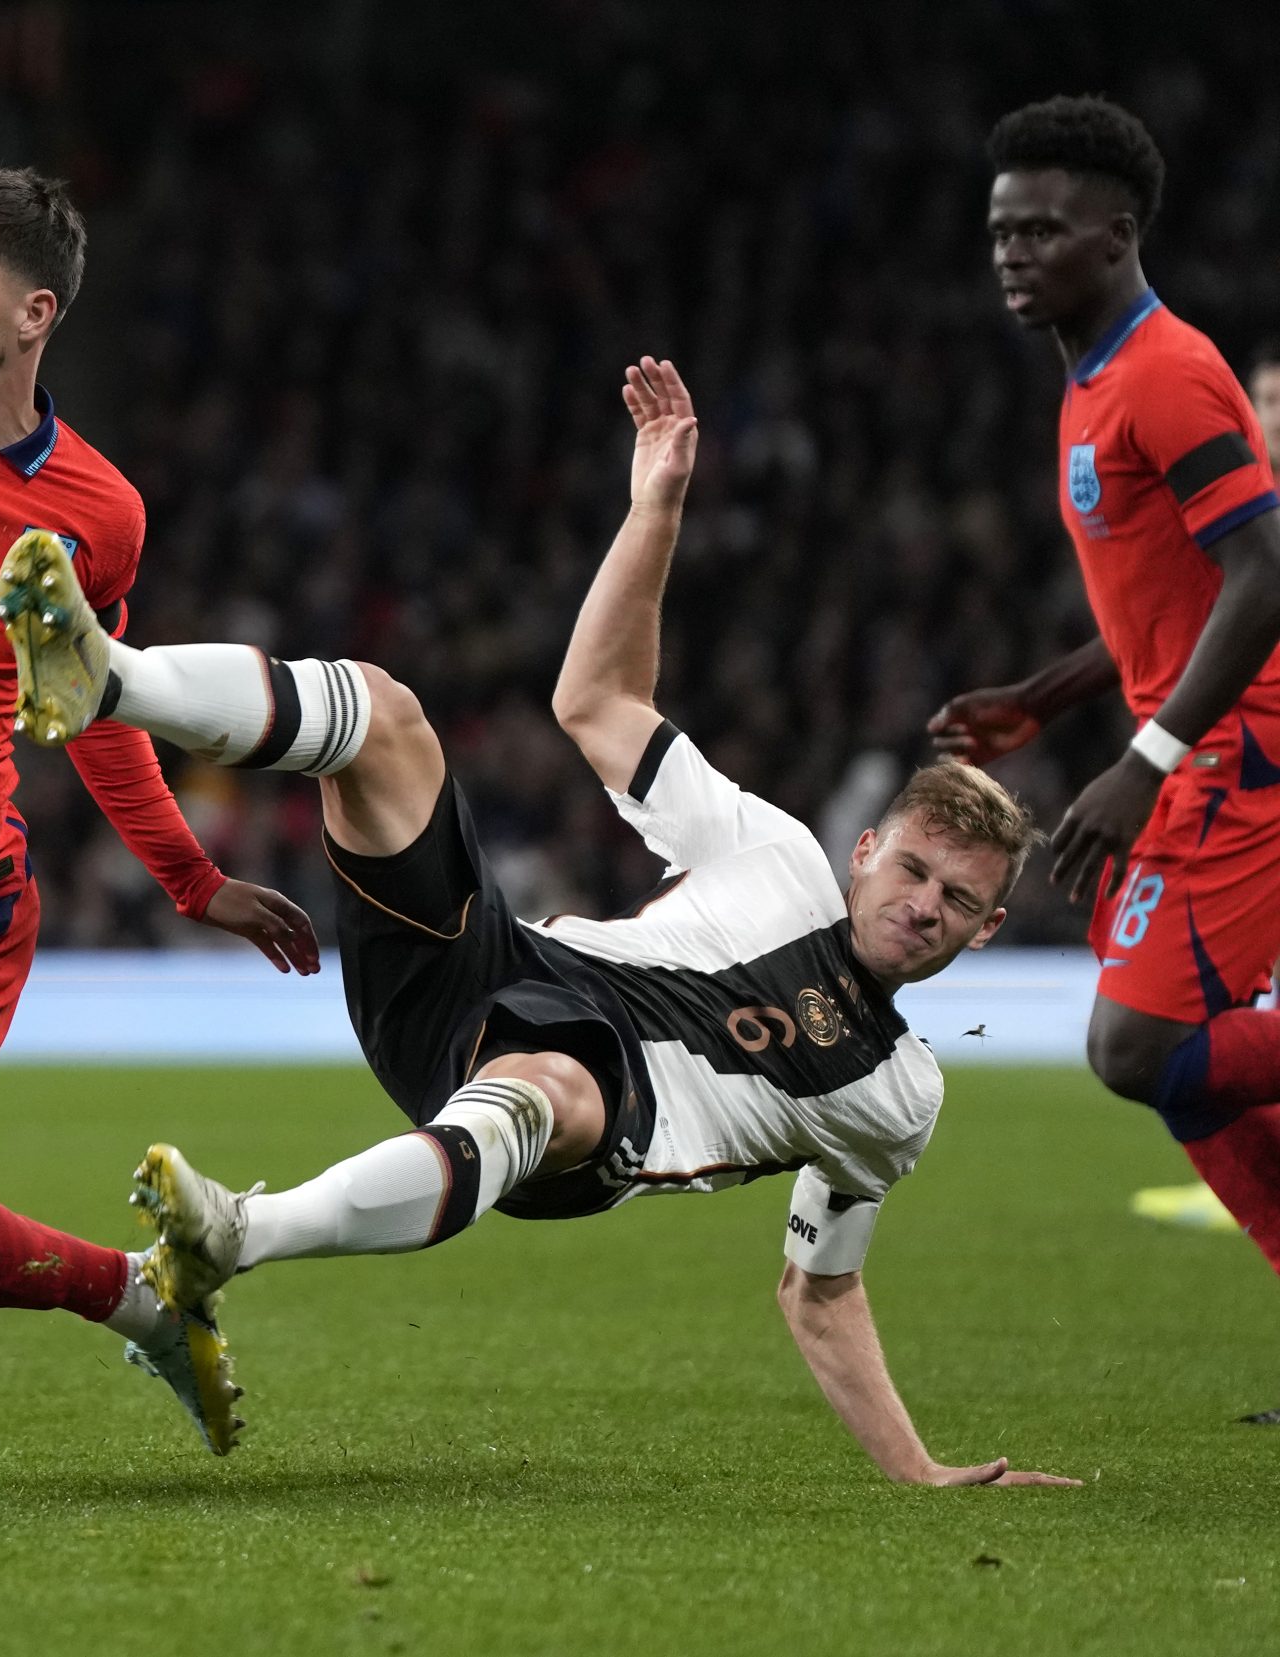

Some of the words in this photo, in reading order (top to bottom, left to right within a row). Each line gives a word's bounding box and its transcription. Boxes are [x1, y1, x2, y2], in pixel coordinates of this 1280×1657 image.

[1110, 863, 1165, 949] 18
[727, 1006, 797, 1053] 6
[787, 1214, 818, 1245] OVE
